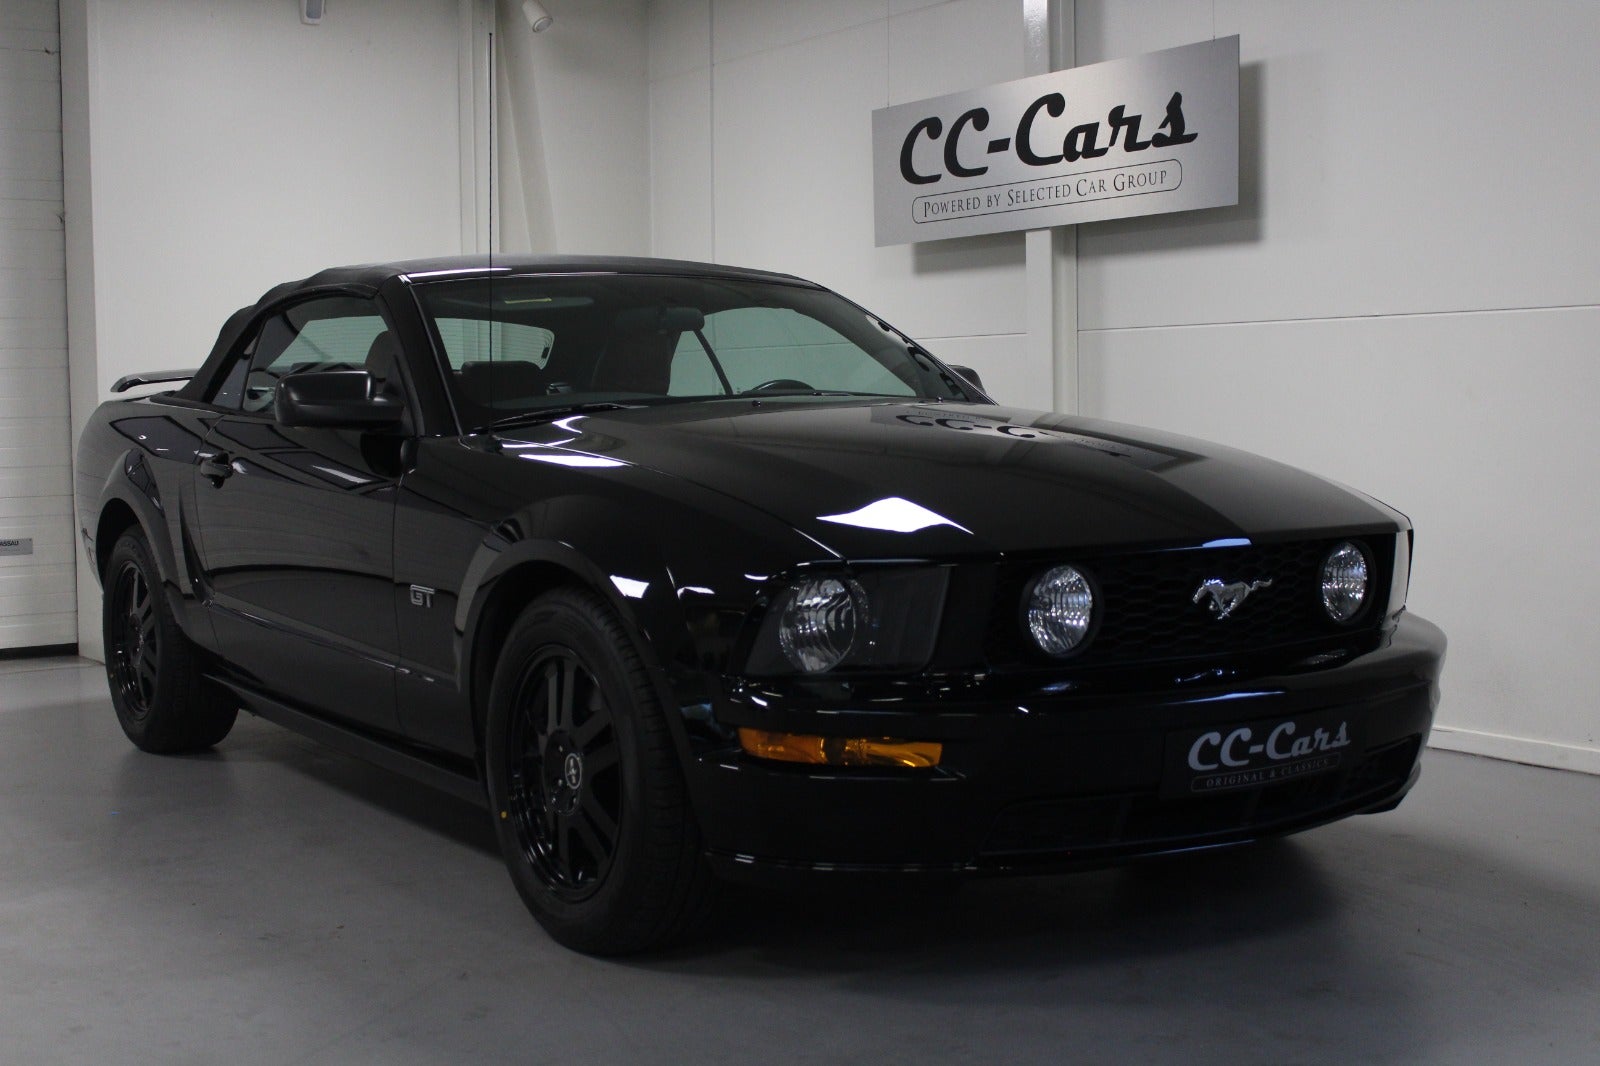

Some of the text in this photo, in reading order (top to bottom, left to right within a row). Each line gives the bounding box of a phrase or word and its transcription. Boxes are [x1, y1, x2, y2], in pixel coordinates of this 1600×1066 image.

[900, 91, 1198, 184] CC-Cars
[987, 193, 1001, 208] BY
[410, 584, 435, 608] GT
[1187, 721, 1350, 771] CC-Cars
